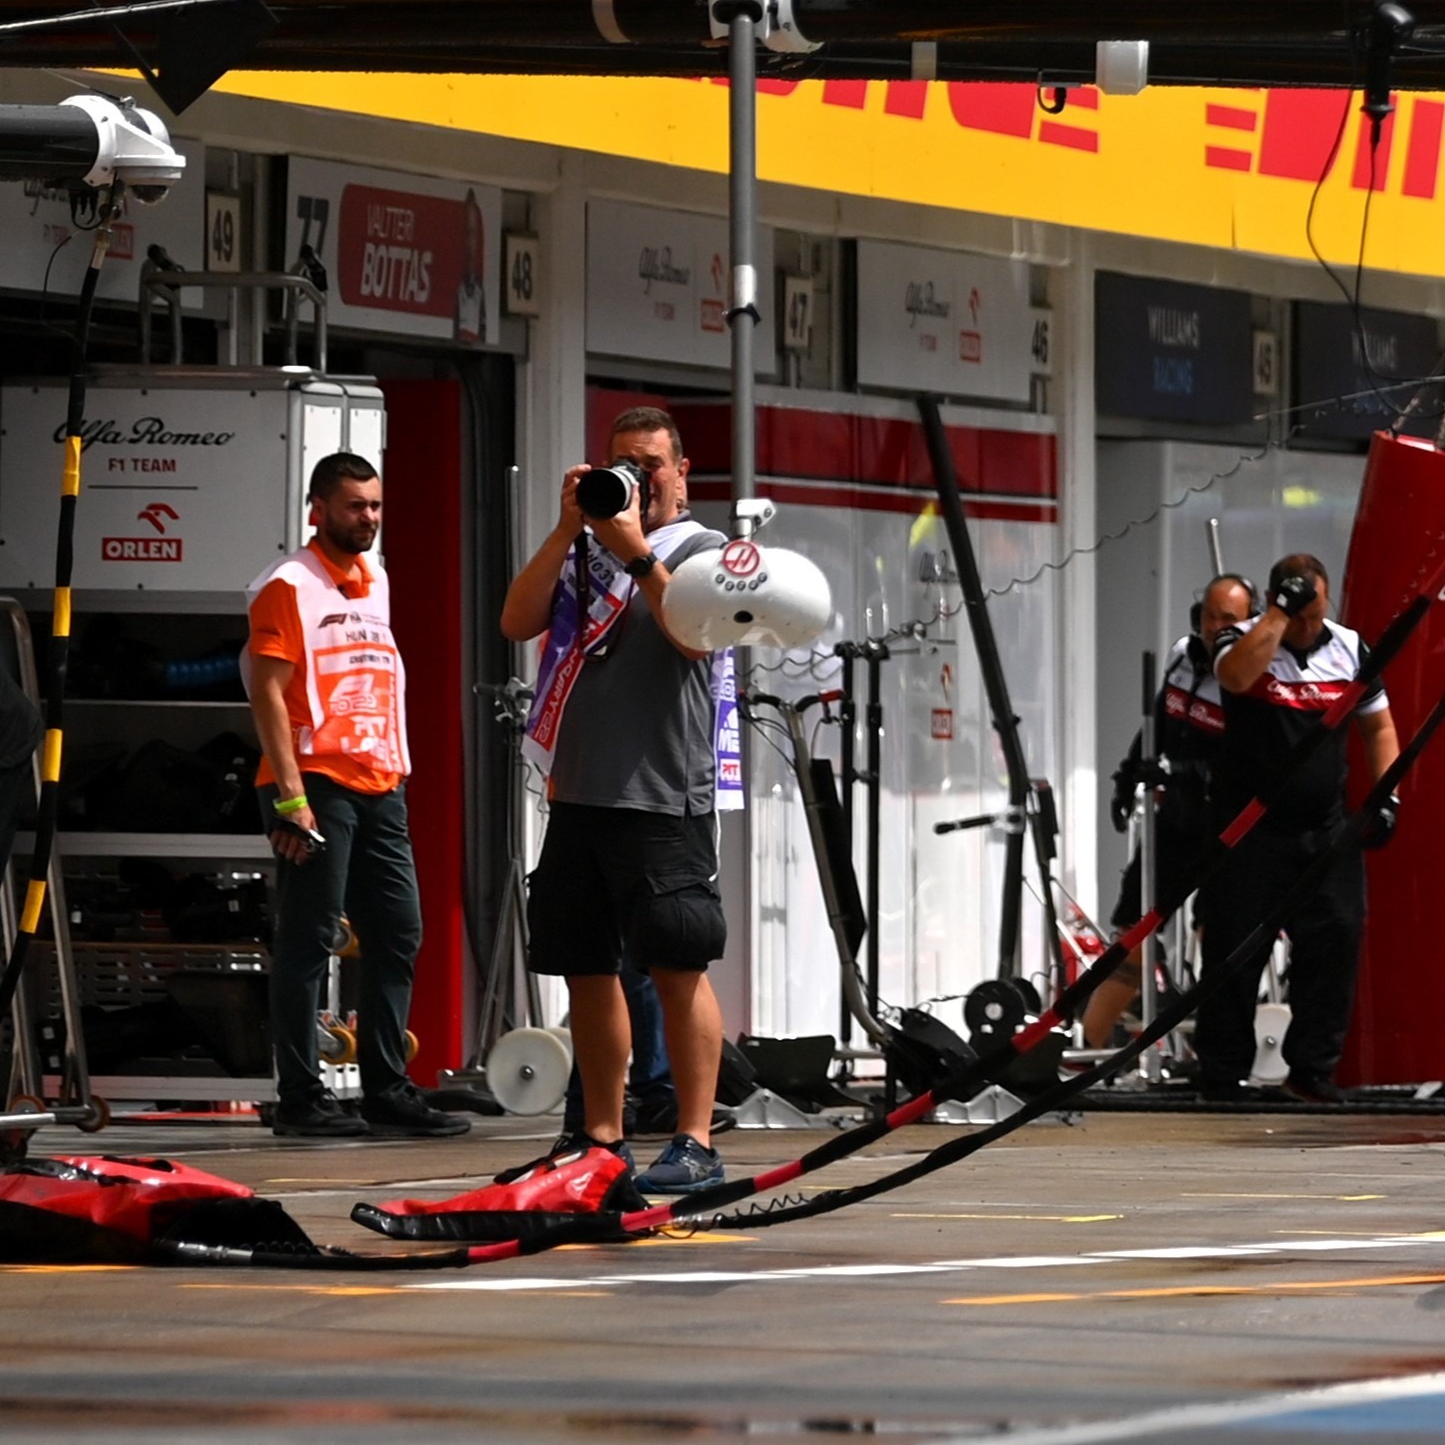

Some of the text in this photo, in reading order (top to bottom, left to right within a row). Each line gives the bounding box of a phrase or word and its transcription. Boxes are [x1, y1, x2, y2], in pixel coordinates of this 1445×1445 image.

[212, 209, 234, 263] 49
[296, 196, 329, 257] 77
[360, 242, 433, 304] BOTTAS
[512, 251, 533, 301] 48
[1032, 319, 1049, 364] 46
[127, 417, 235, 446] Romeo
[108, 458, 176, 473] F1 TEAM
[105, 540, 178, 559] ORLEN
